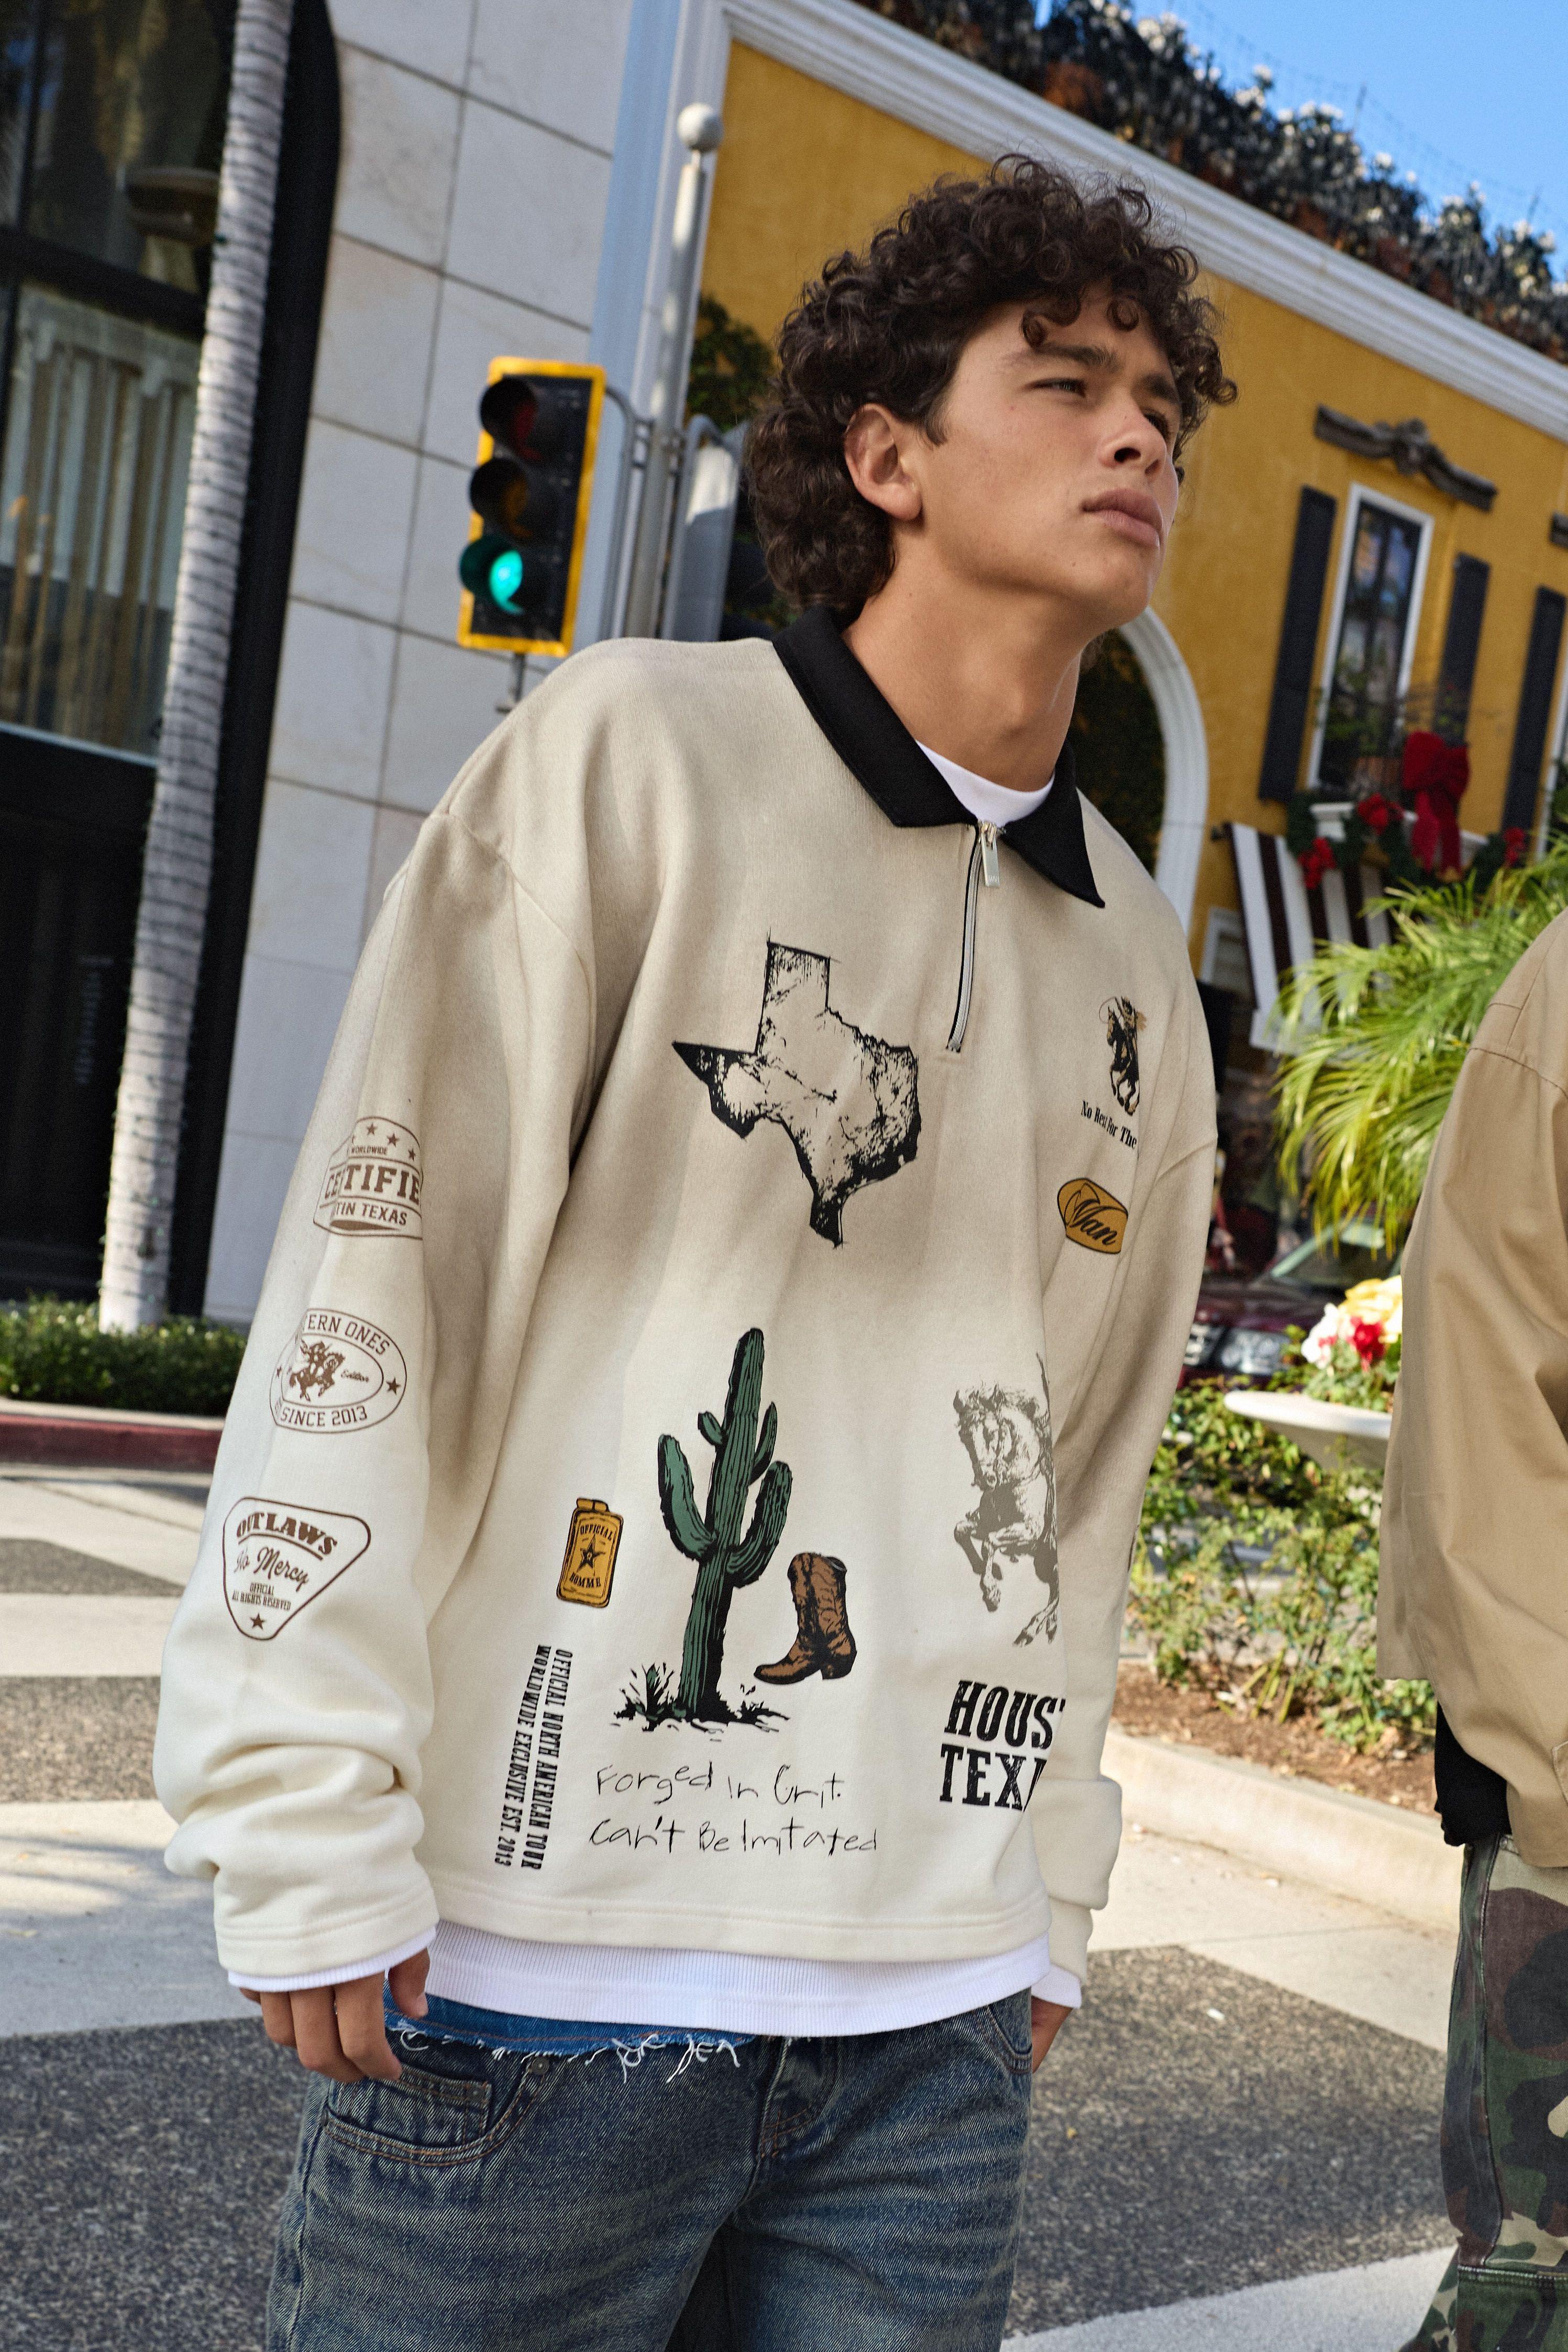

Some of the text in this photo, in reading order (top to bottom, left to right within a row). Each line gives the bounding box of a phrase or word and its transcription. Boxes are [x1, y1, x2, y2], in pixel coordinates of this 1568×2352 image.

[1081, 1101, 1092, 1119] No
[1107, 1117, 1118, 1136] For
[1120, 1125, 1137, 1149] The
[351, 1145, 388, 1155] WORLDWIDE
[362, 1204, 407, 1225] TEXAS
[345, 1321, 390, 1355] ONES
[281, 1406, 368, 1427] SINCE 2013
[237, 1512, 338, 1554] OUTLAWS
[580, 1523, 613, 1541] OFFICIAL
[253, 1547, 309, 1592] Mercy
[240, 1592, 261, 1605] RIGHTS
[263, 1595, 291, 1611] RESERVED
[249, 1582, 274, 1596] OFFICIAL
[494, 1644, 551, 1866] WORLDWIDE EXCLUSIVE EST. 2013
[521, 1649, 573, 1869] OFFICIAL NORTH AMERICAN TOUR
[597, 1760, 713, 1805] Forged
[727, 1775, 759, 1799] In
[589, 1815, 686, 1853] Can't
[699, 1820, 730, 1852] Be
